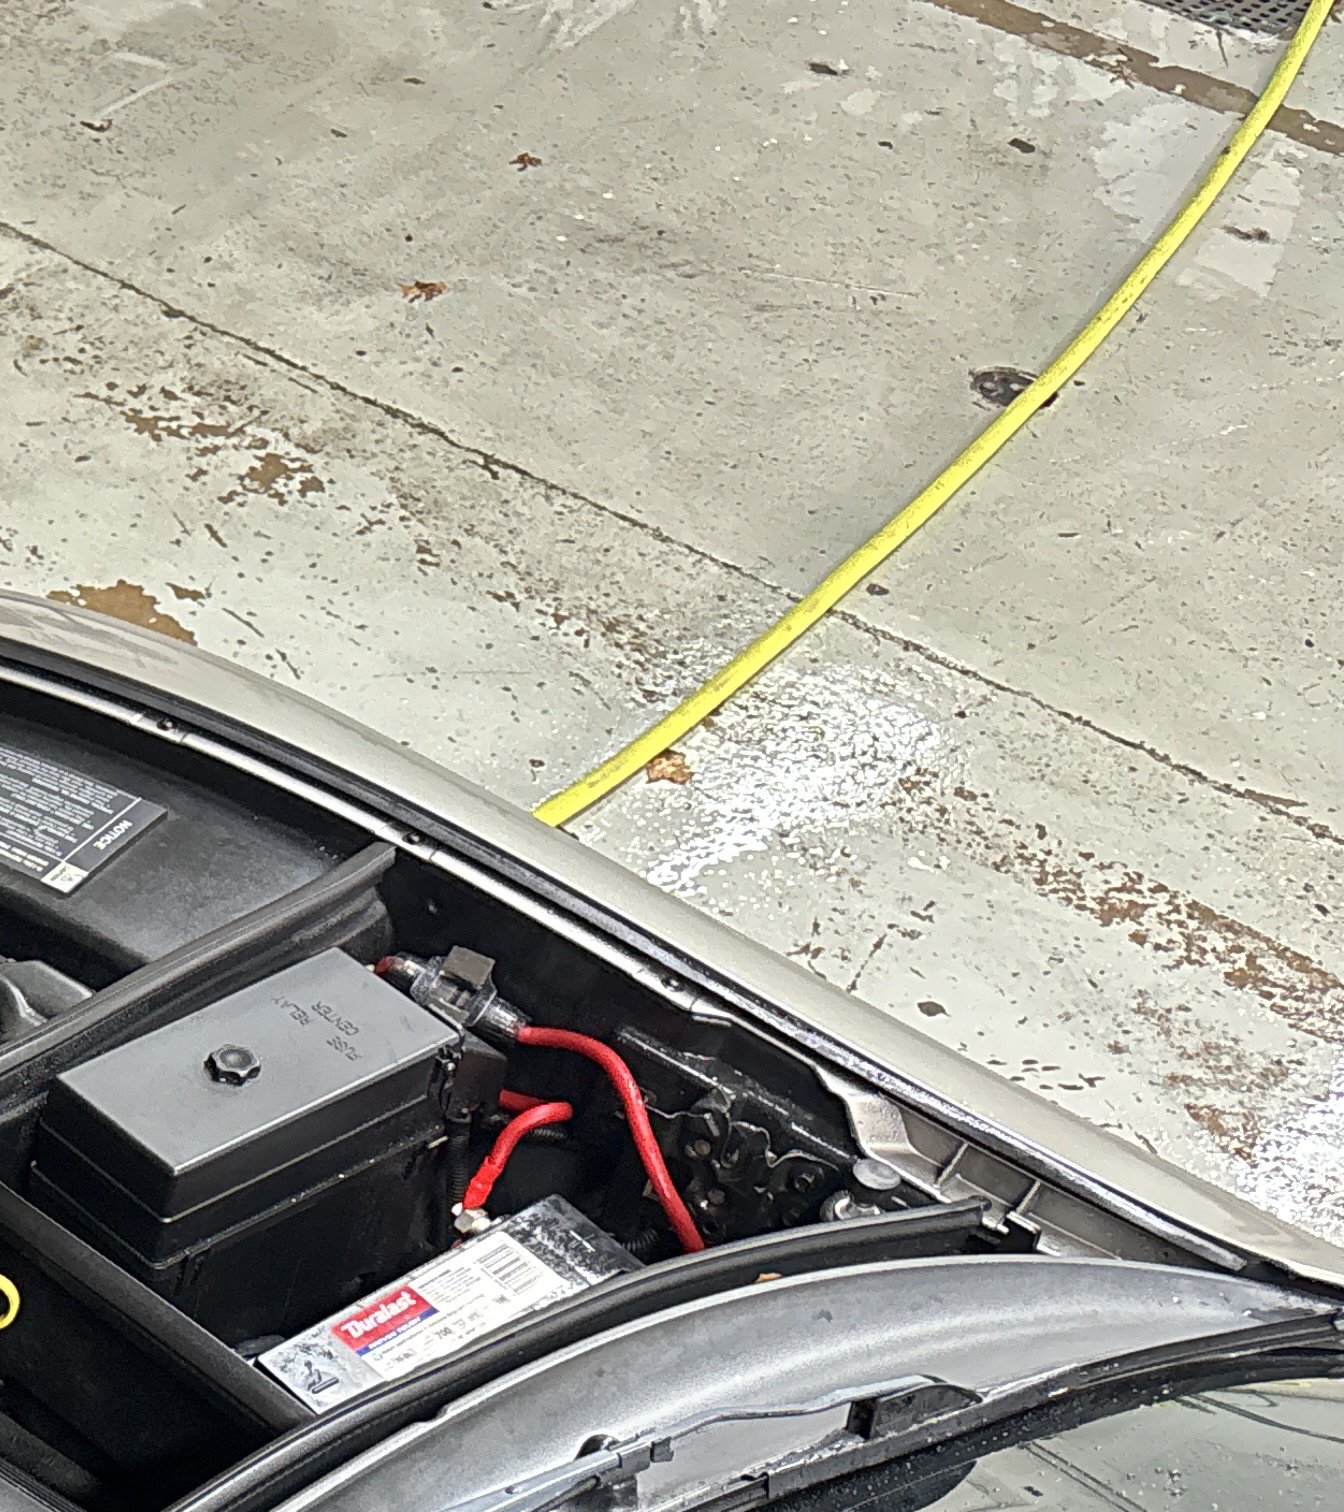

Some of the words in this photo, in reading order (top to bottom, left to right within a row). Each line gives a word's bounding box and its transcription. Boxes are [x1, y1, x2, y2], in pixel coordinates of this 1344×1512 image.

[93, 820, 133, 850] NOTICE
[311, 1001, 359, 1036] CENTER
[341, 1291, 418, 1339] Duralast
